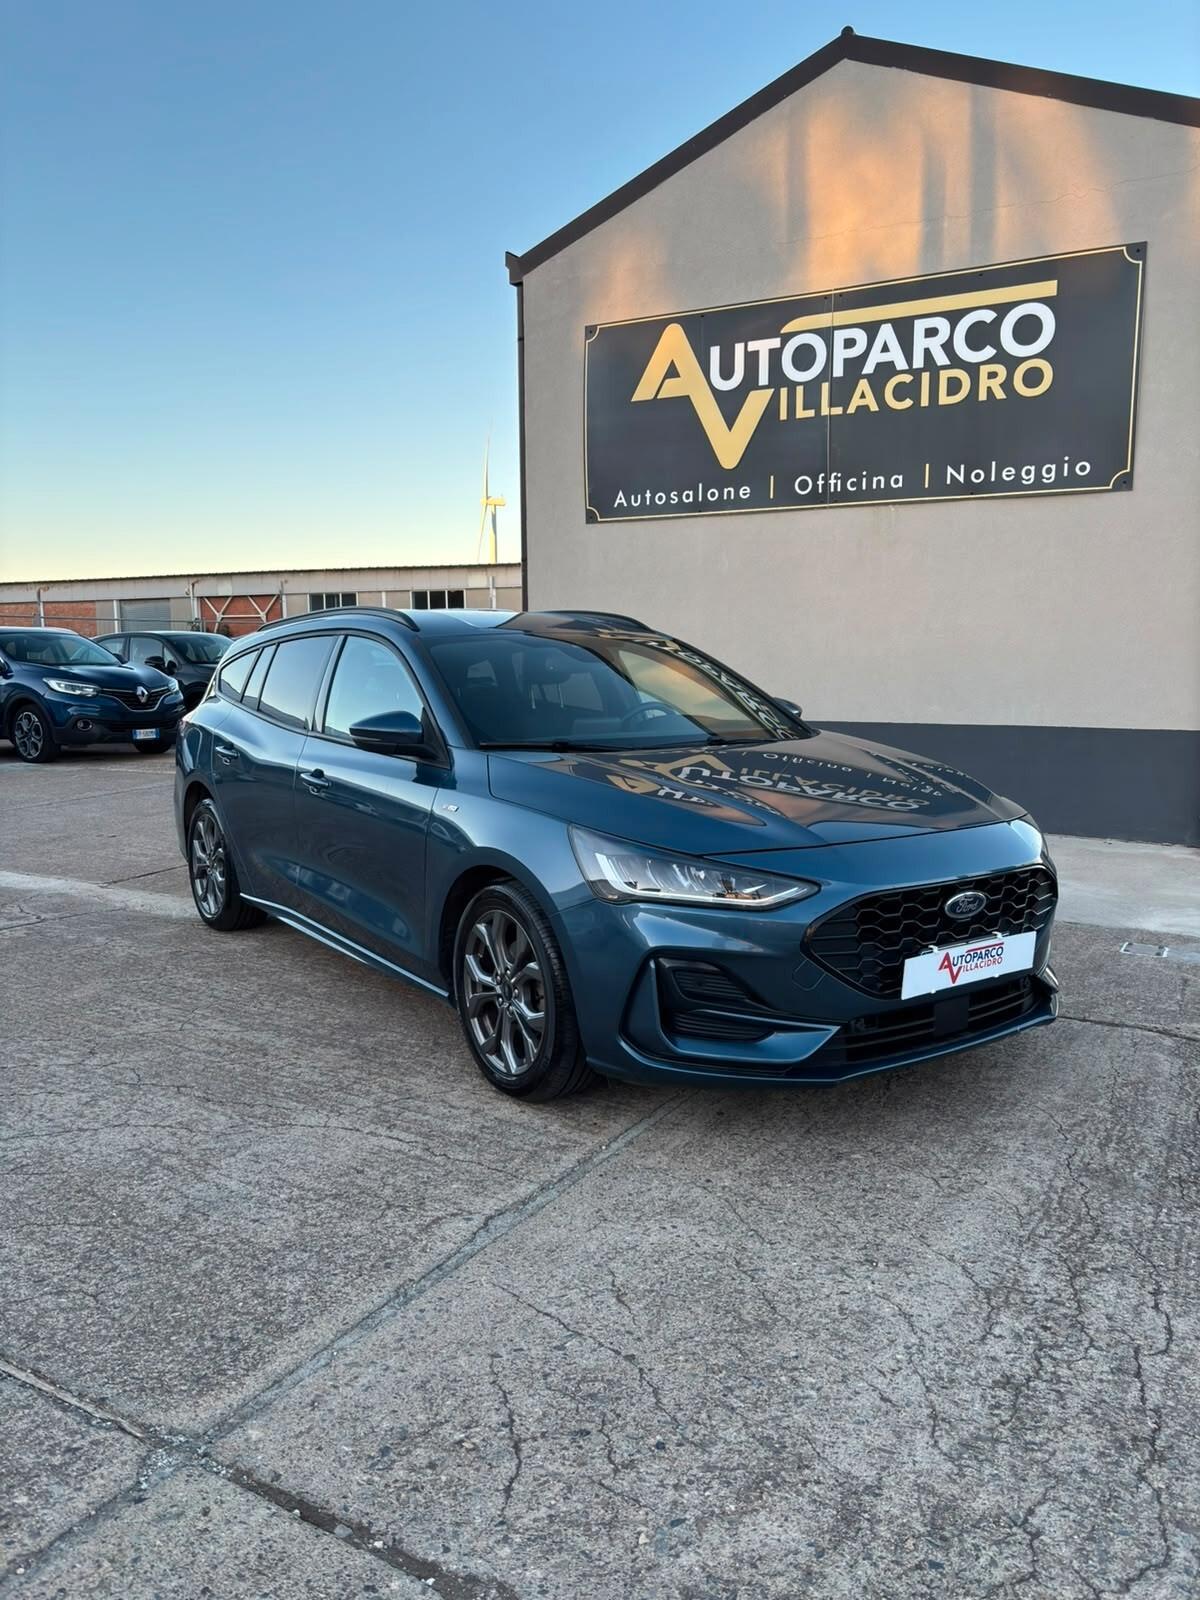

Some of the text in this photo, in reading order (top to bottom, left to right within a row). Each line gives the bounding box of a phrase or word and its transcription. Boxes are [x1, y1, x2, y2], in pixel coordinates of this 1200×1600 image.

[631, 301, 1056, 402] AUTOPARCO
[690, 357, 1054, 470] VILLACIDRO
[613, 455, 1091, 508] Autosalone Officina Noleggio
[955, 896, 979, 913] Ford
[938, 946, 1004, 971] AUTOPARCO
[949, 957, 1003, 985] VILLACIDRO
